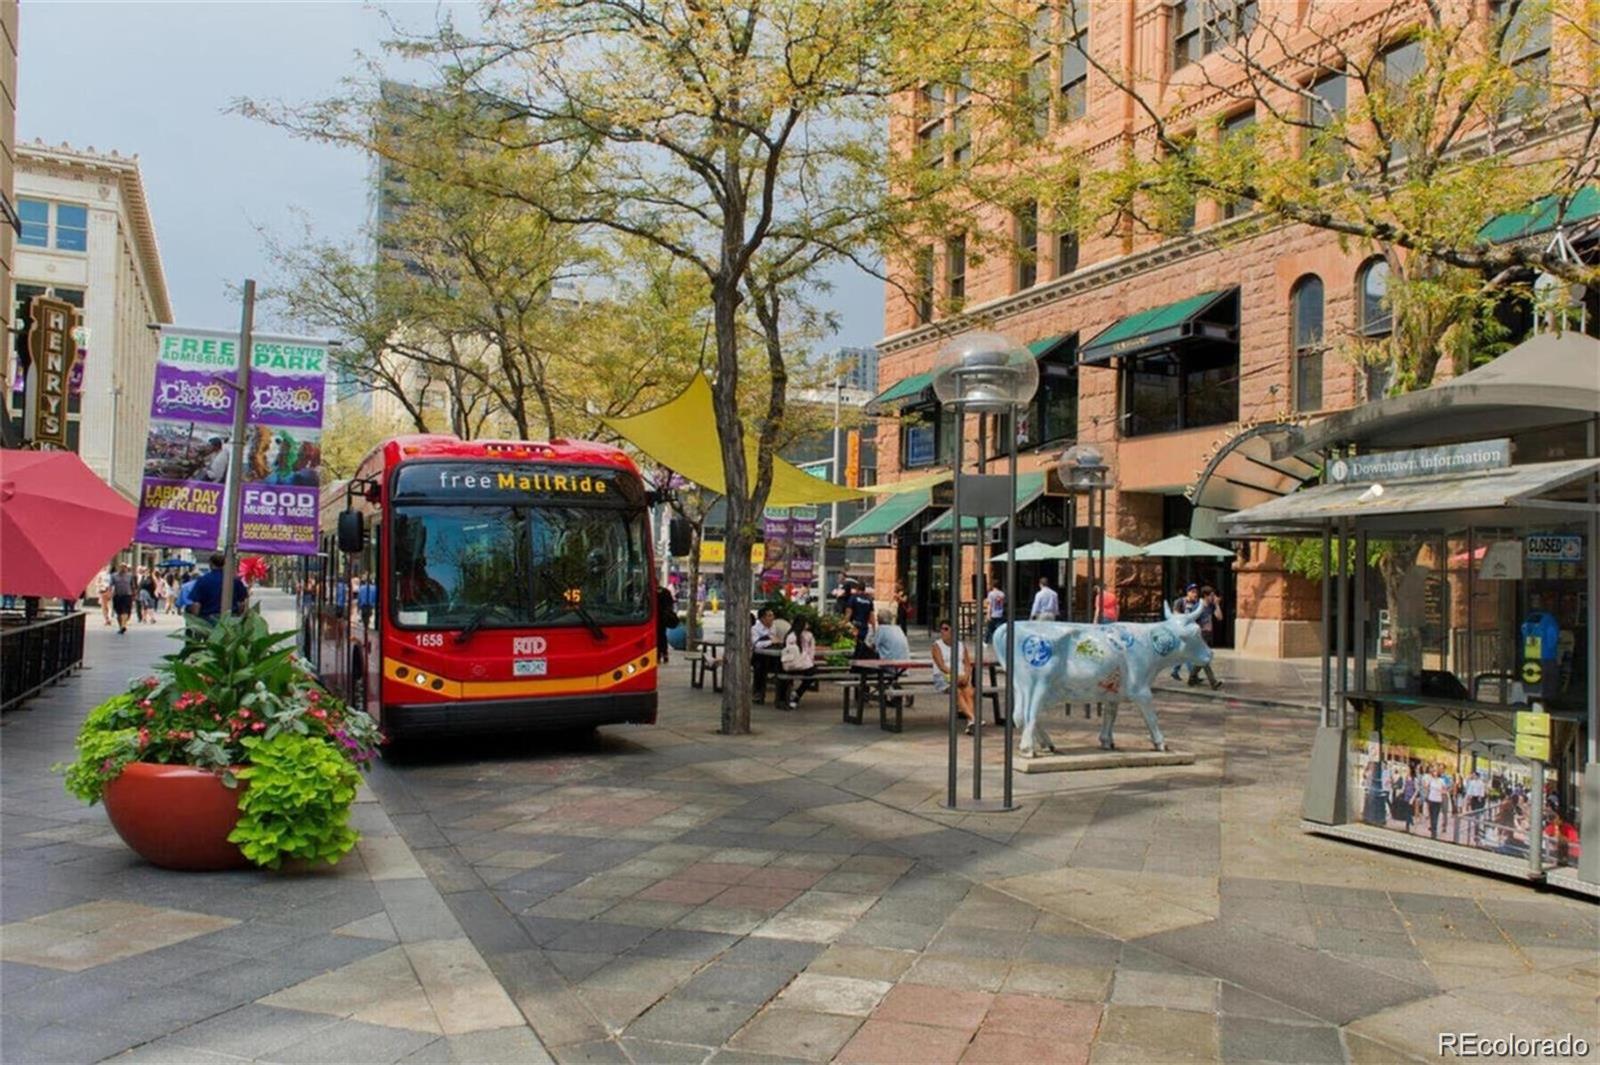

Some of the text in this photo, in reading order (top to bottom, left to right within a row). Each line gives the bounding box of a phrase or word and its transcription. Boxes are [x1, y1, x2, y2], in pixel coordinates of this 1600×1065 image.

[164, 337, 235, 357] FREE
[255, 343, 324, 357] CIVIC CENTER
[162, 351, 235, 367] ADMISSION
[254, 353, 322, 371] PARK
[1352, 459, 1417, 476] Downtown
[440, 471, 607, 493] free MallRide
[145, 485, 220, 505] LABOR DAY
[245, 490, 314, 508] FOOD
[144, 497, 218, 515] WEEKEND
[243, 505, 276, 516] MUSIC
[286, 507, 314, 518] MORE
[1528, 538, 1562, 553] CLOSED
[415, 634, 444, 647] 1658
[513, 636, 547, 655] RTD
